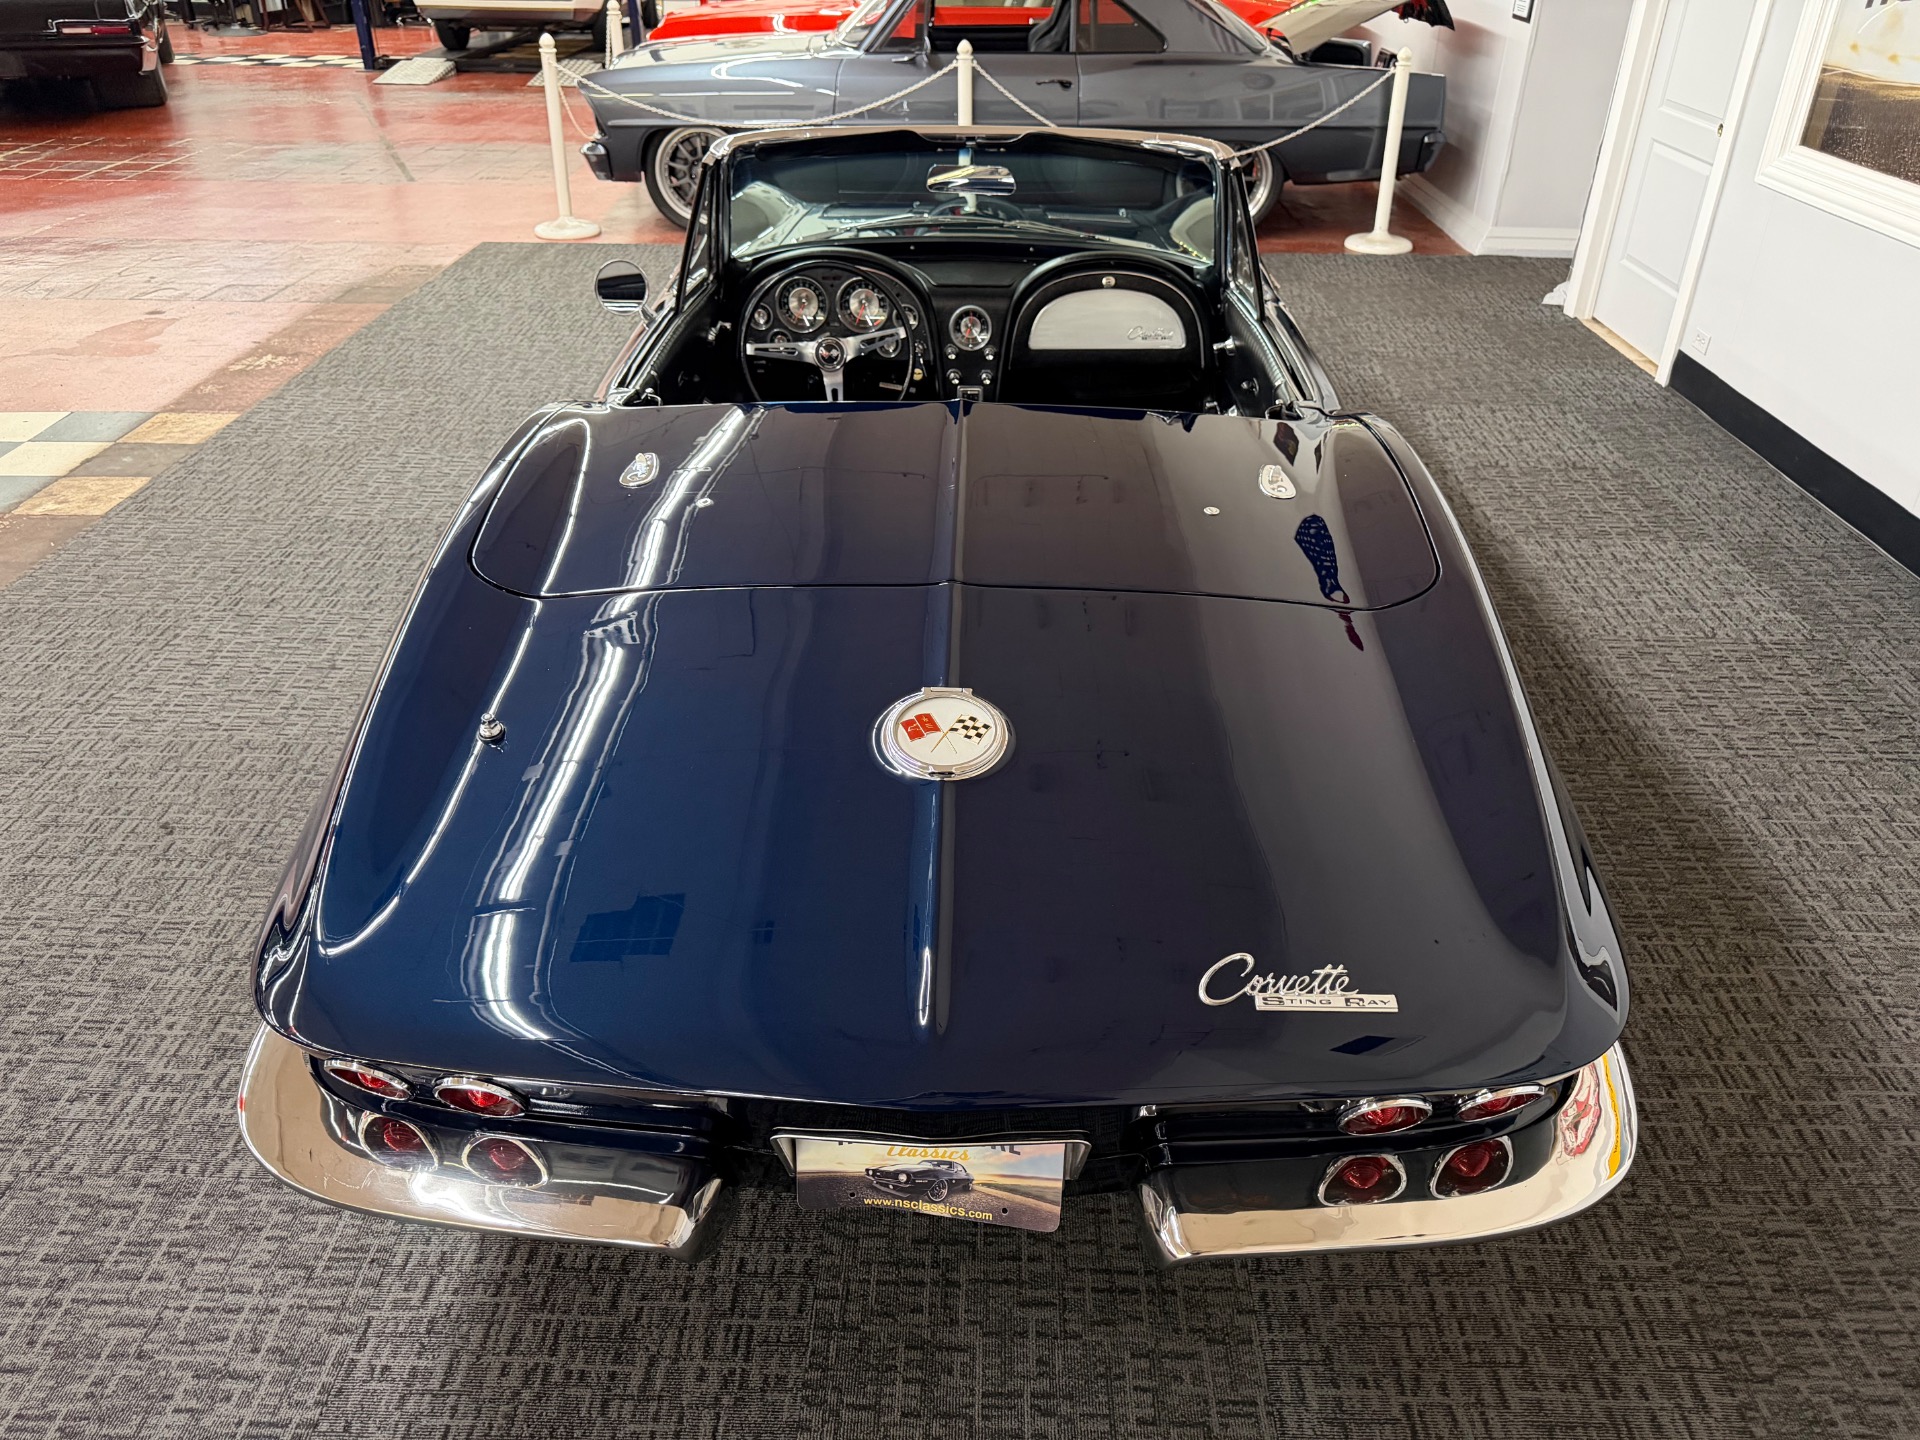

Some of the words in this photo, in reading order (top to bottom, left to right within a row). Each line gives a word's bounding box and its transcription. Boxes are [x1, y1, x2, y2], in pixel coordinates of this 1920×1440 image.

[1198, 952, 1360, 1006] Corvette
[1262, 996, 1332, 1006] STING
[1344, 997, 1392, 1007] RAY
[863, 1197, 993, 1221] www.nsclassics.com
